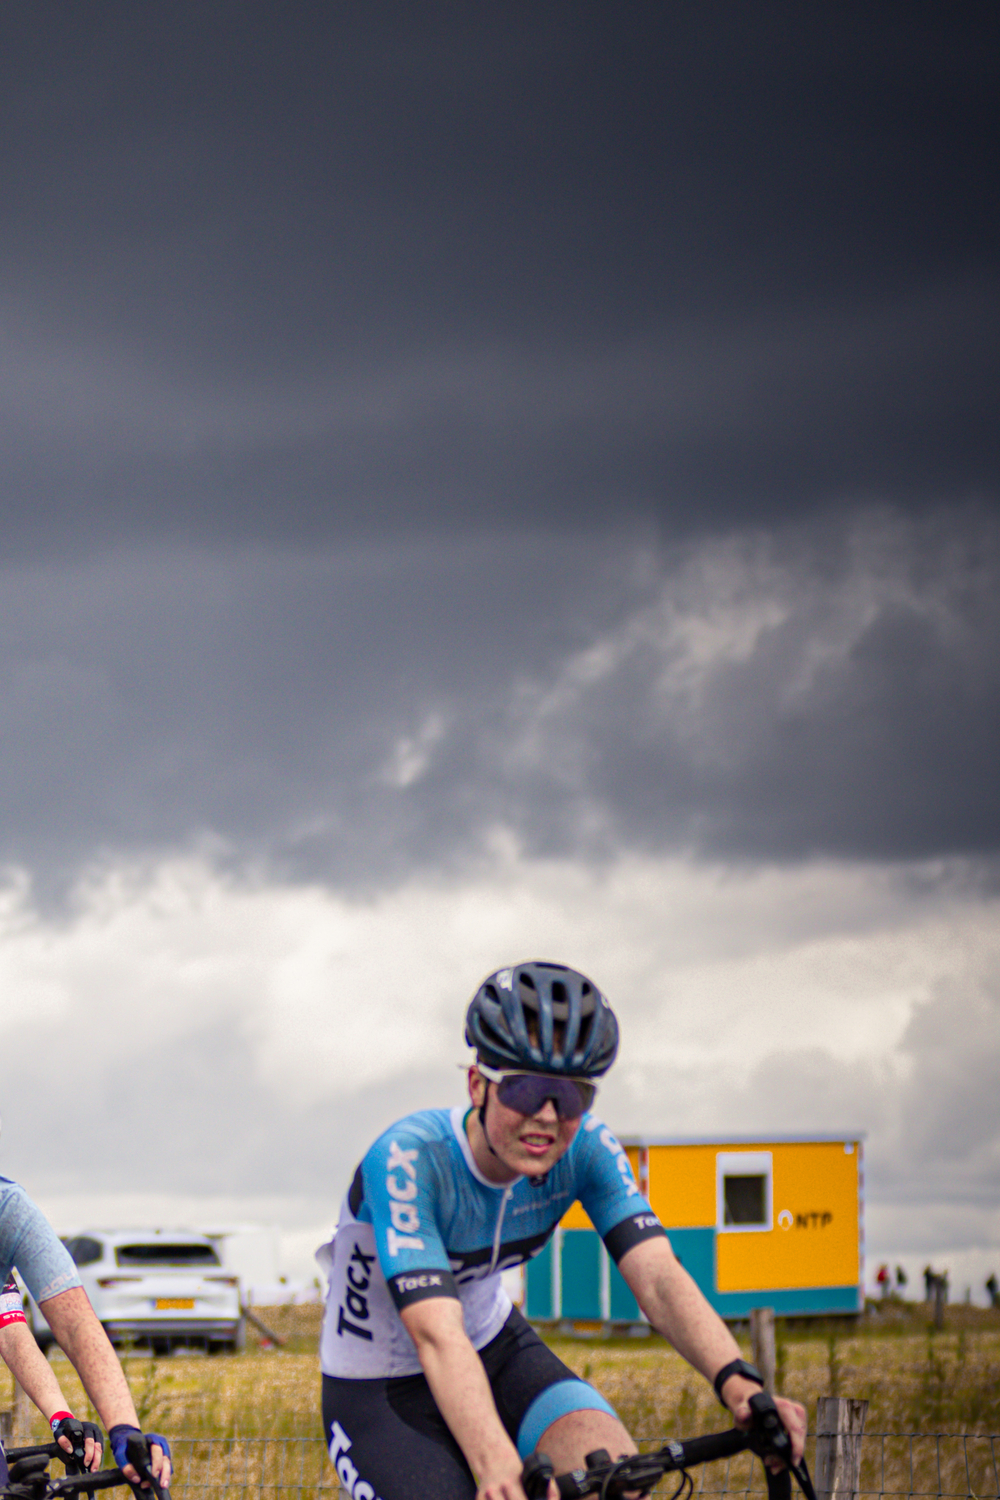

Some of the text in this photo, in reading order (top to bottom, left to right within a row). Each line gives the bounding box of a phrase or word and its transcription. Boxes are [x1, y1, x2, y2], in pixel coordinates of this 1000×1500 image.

[386, 1140, 425, 1257] Tacx
[796, 1211, 833, 1229] NTP
[337, 1242, 376, 1342] Tacx
[396, 1273, 442, 1294] Tacx
